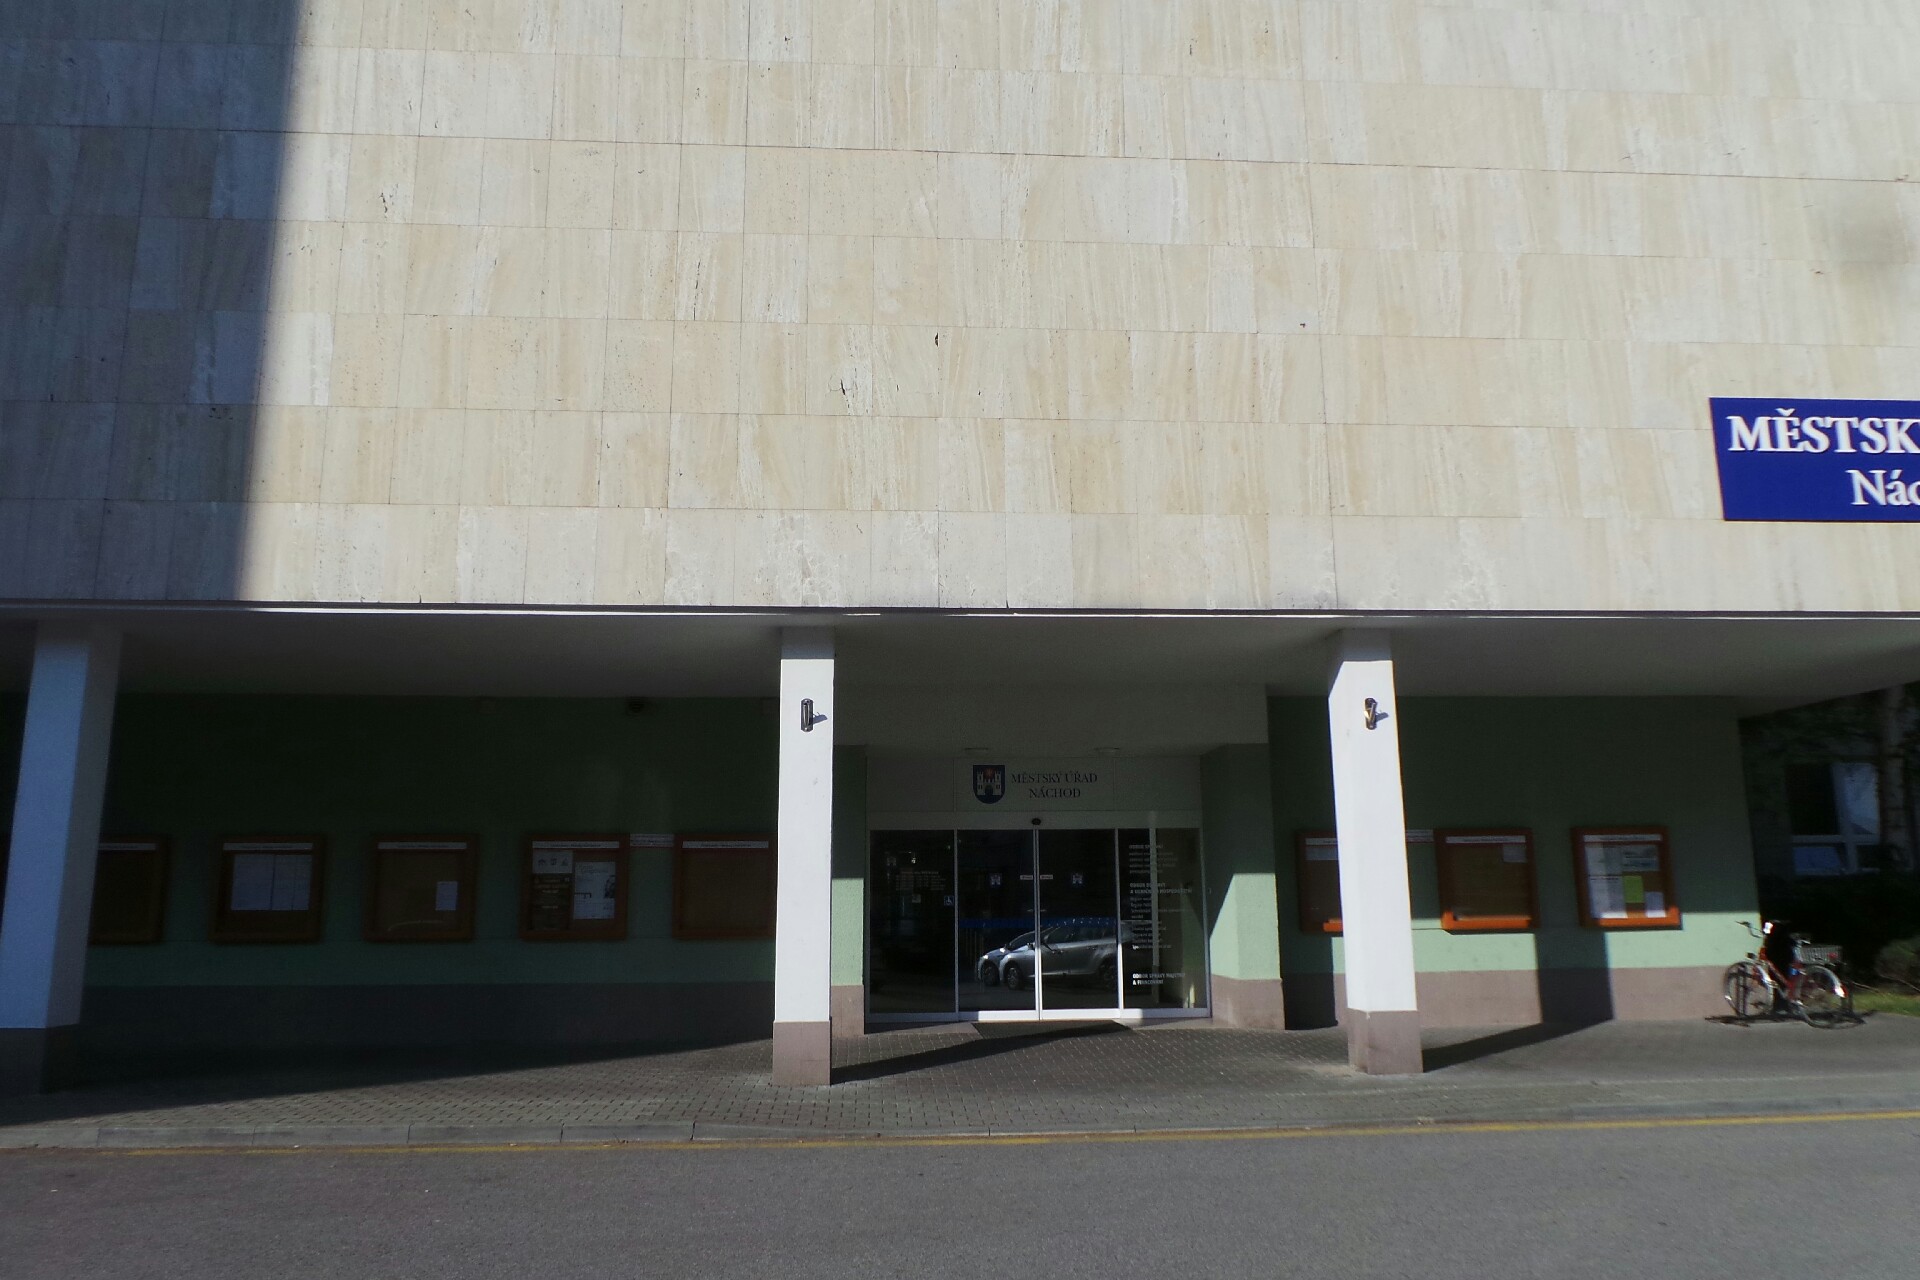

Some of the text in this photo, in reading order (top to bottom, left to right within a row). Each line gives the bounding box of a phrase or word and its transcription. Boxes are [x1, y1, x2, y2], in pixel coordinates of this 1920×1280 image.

[1011, 769, 1098, 784] MĚSTSKÝ ÚŘAD
[1029, 785, 1081, 799] NÁCHOD
